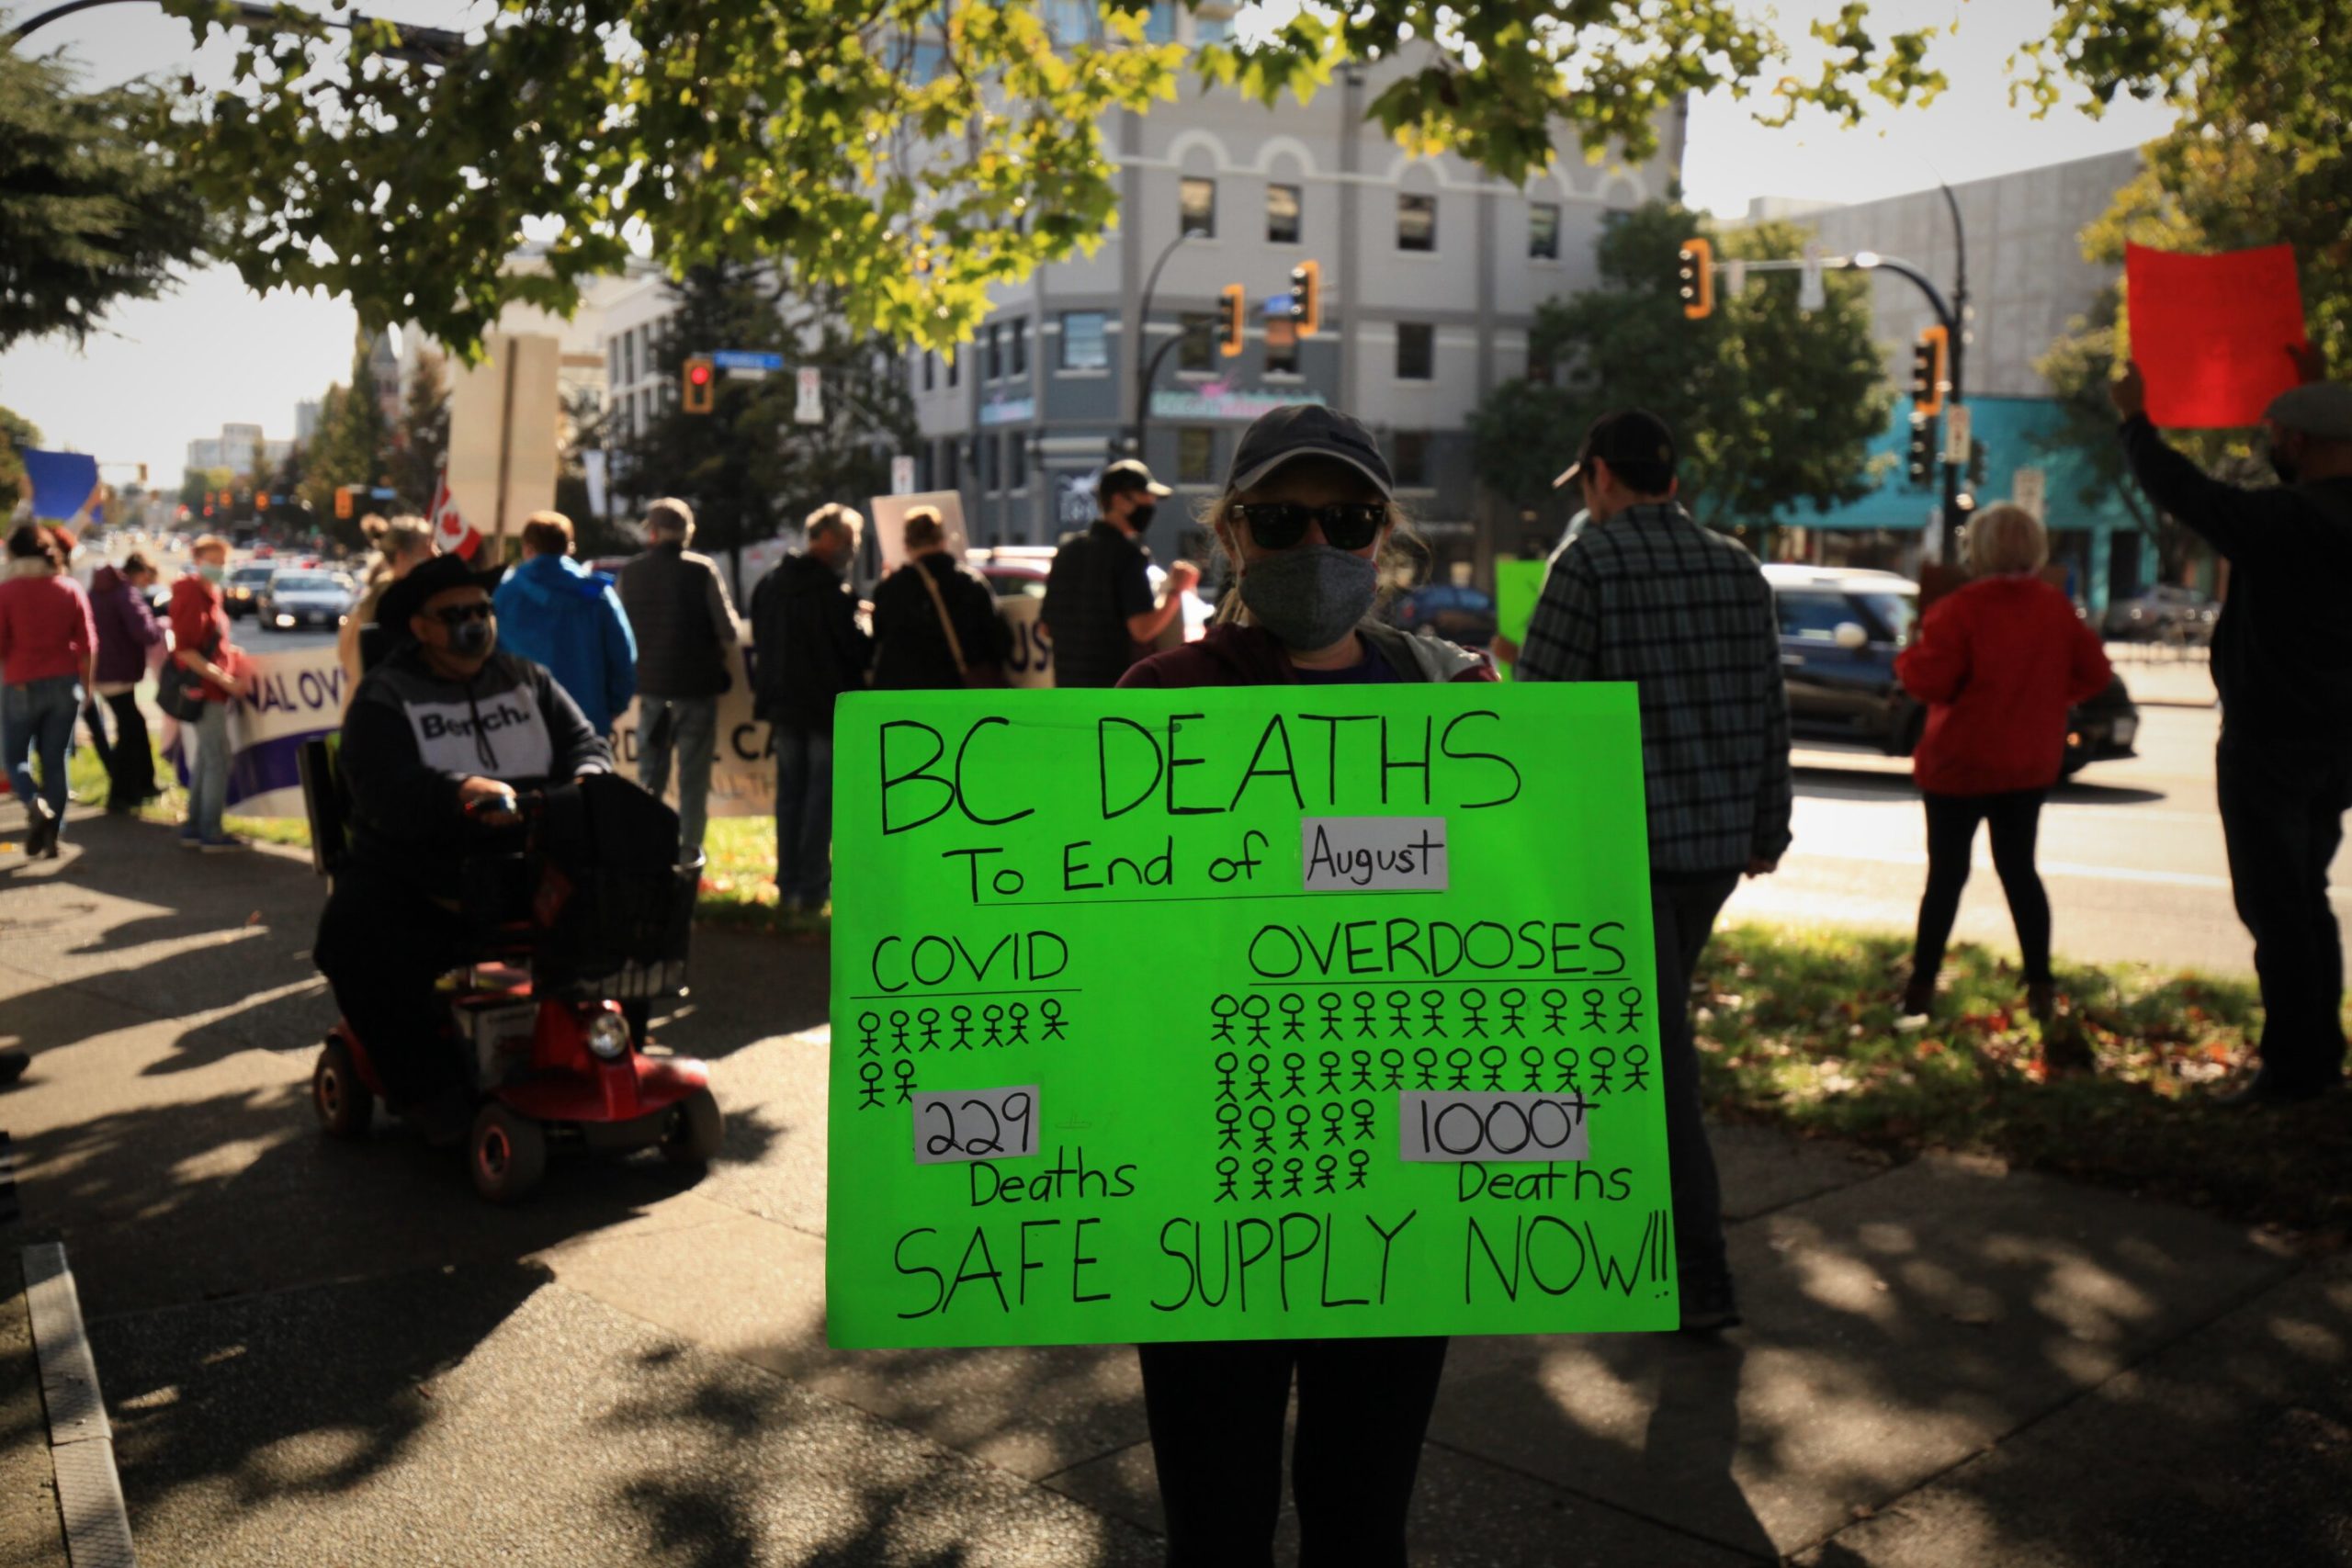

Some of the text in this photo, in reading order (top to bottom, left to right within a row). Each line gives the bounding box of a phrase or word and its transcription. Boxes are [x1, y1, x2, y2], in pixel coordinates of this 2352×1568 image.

[879, 710, 1521, 836] BC DEATHS
[942, 823, 1445, 903] To End of August
[872, 931, 1069, 993] COVID
[1249, 918, 1626, 978] OVERDOSES
[924, 1091, 1032, 1156] 229
[1420, 1086, 1601, 1156] 1000+
[969, 1145, 1137, 1207] Deaths
[1458, 1159, 1633, 1202] Deaths
[894, 1209, 1669, 1320] SAFE SUPPLY NOW!!
